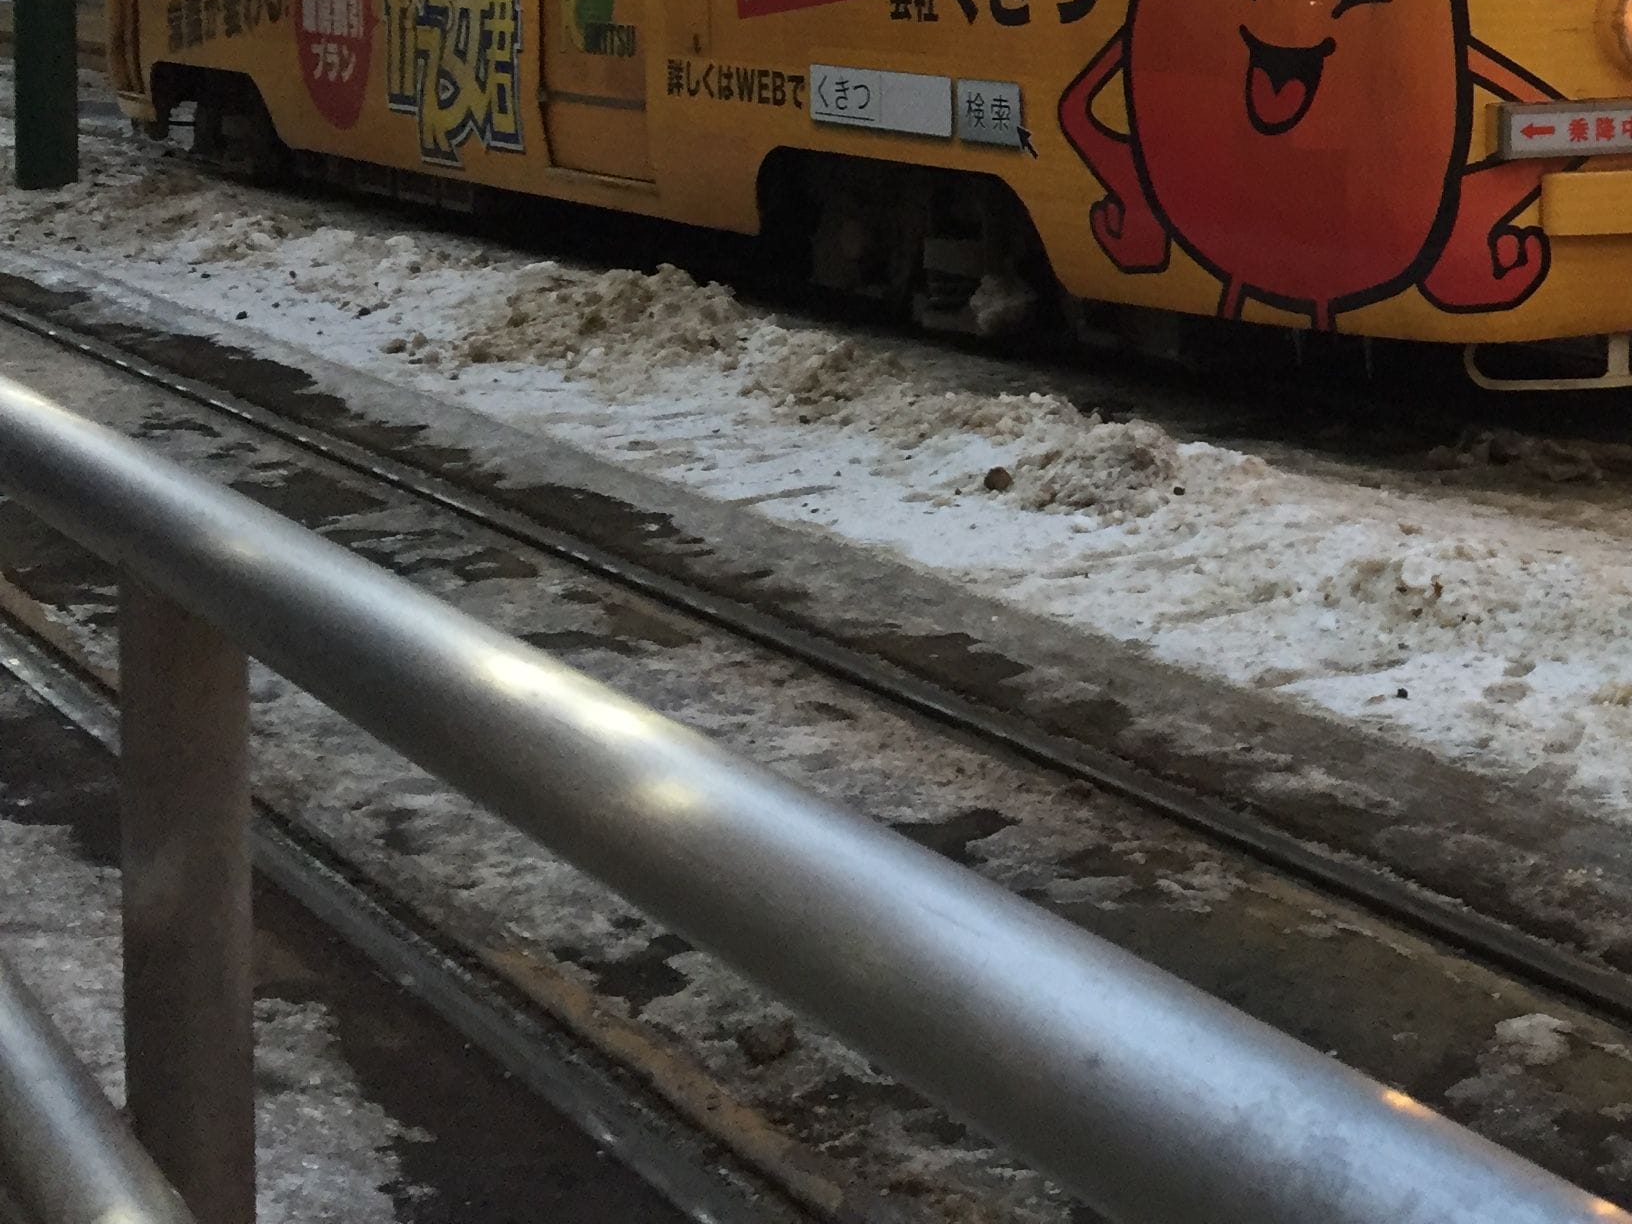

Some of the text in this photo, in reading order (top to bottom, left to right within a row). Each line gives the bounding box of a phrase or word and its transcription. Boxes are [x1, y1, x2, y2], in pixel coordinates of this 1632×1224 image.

[815, 75, 872, 112] くきつ
[964, 92, 1012, 130] 検索
